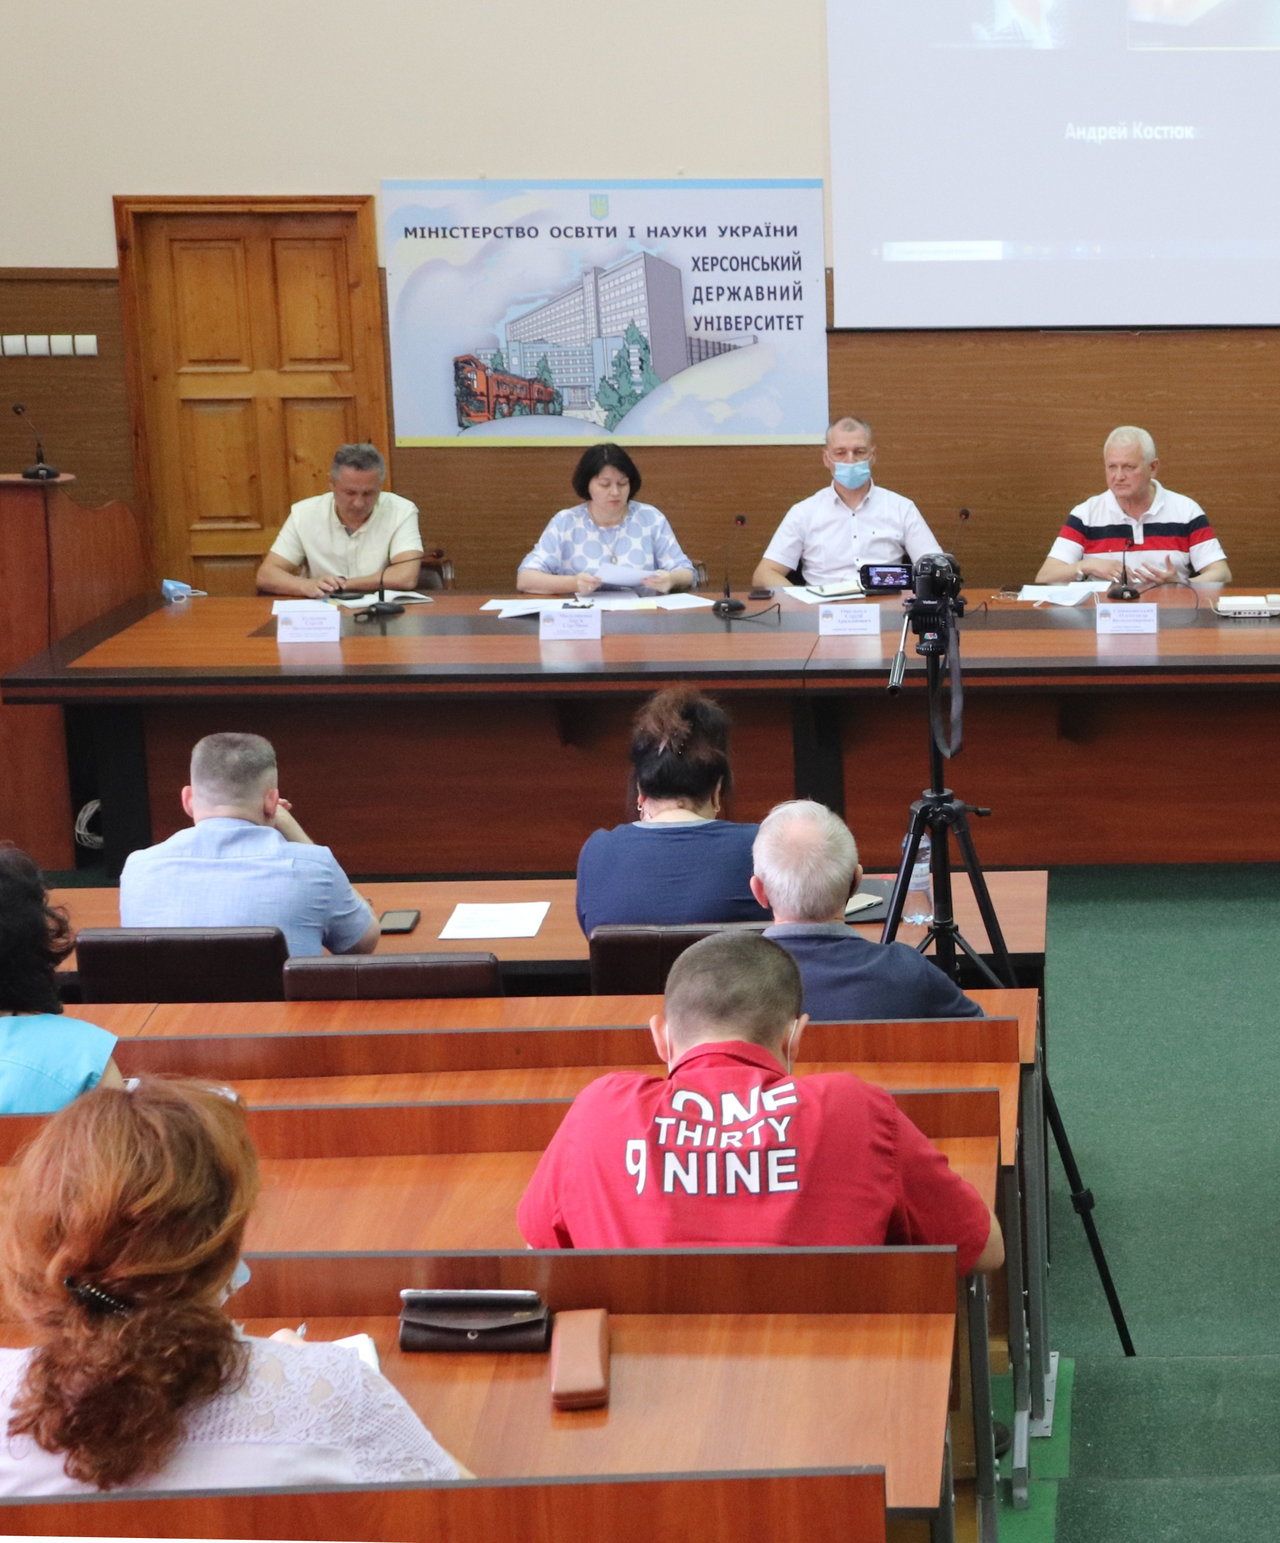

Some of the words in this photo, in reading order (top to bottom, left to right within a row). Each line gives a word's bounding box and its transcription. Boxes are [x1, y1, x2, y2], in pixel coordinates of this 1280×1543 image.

[1066, 121, 1128, 143] Андрей
[1133, 122, 1195, 140] Костюк
[403, 226, 540, 240] МІНІСТЕРСТВО
[550, 226, 618, 239] ОСВІТИ
[647, 226, 708, 239] НАУКИ
[718, 222, 799, 239] УКРАЇНИ
[691, 252, 802, 273] ХЕРСОНСЬКИЙ
[692, 281, 803, 305] ДЕРЖАВНИЙ
[693, 314, 804, 332] УНІВЕРСИТЕТ
[654, 1115, 792, 1149] THIRTY
[663, 1148, 799, 1195] NINE
